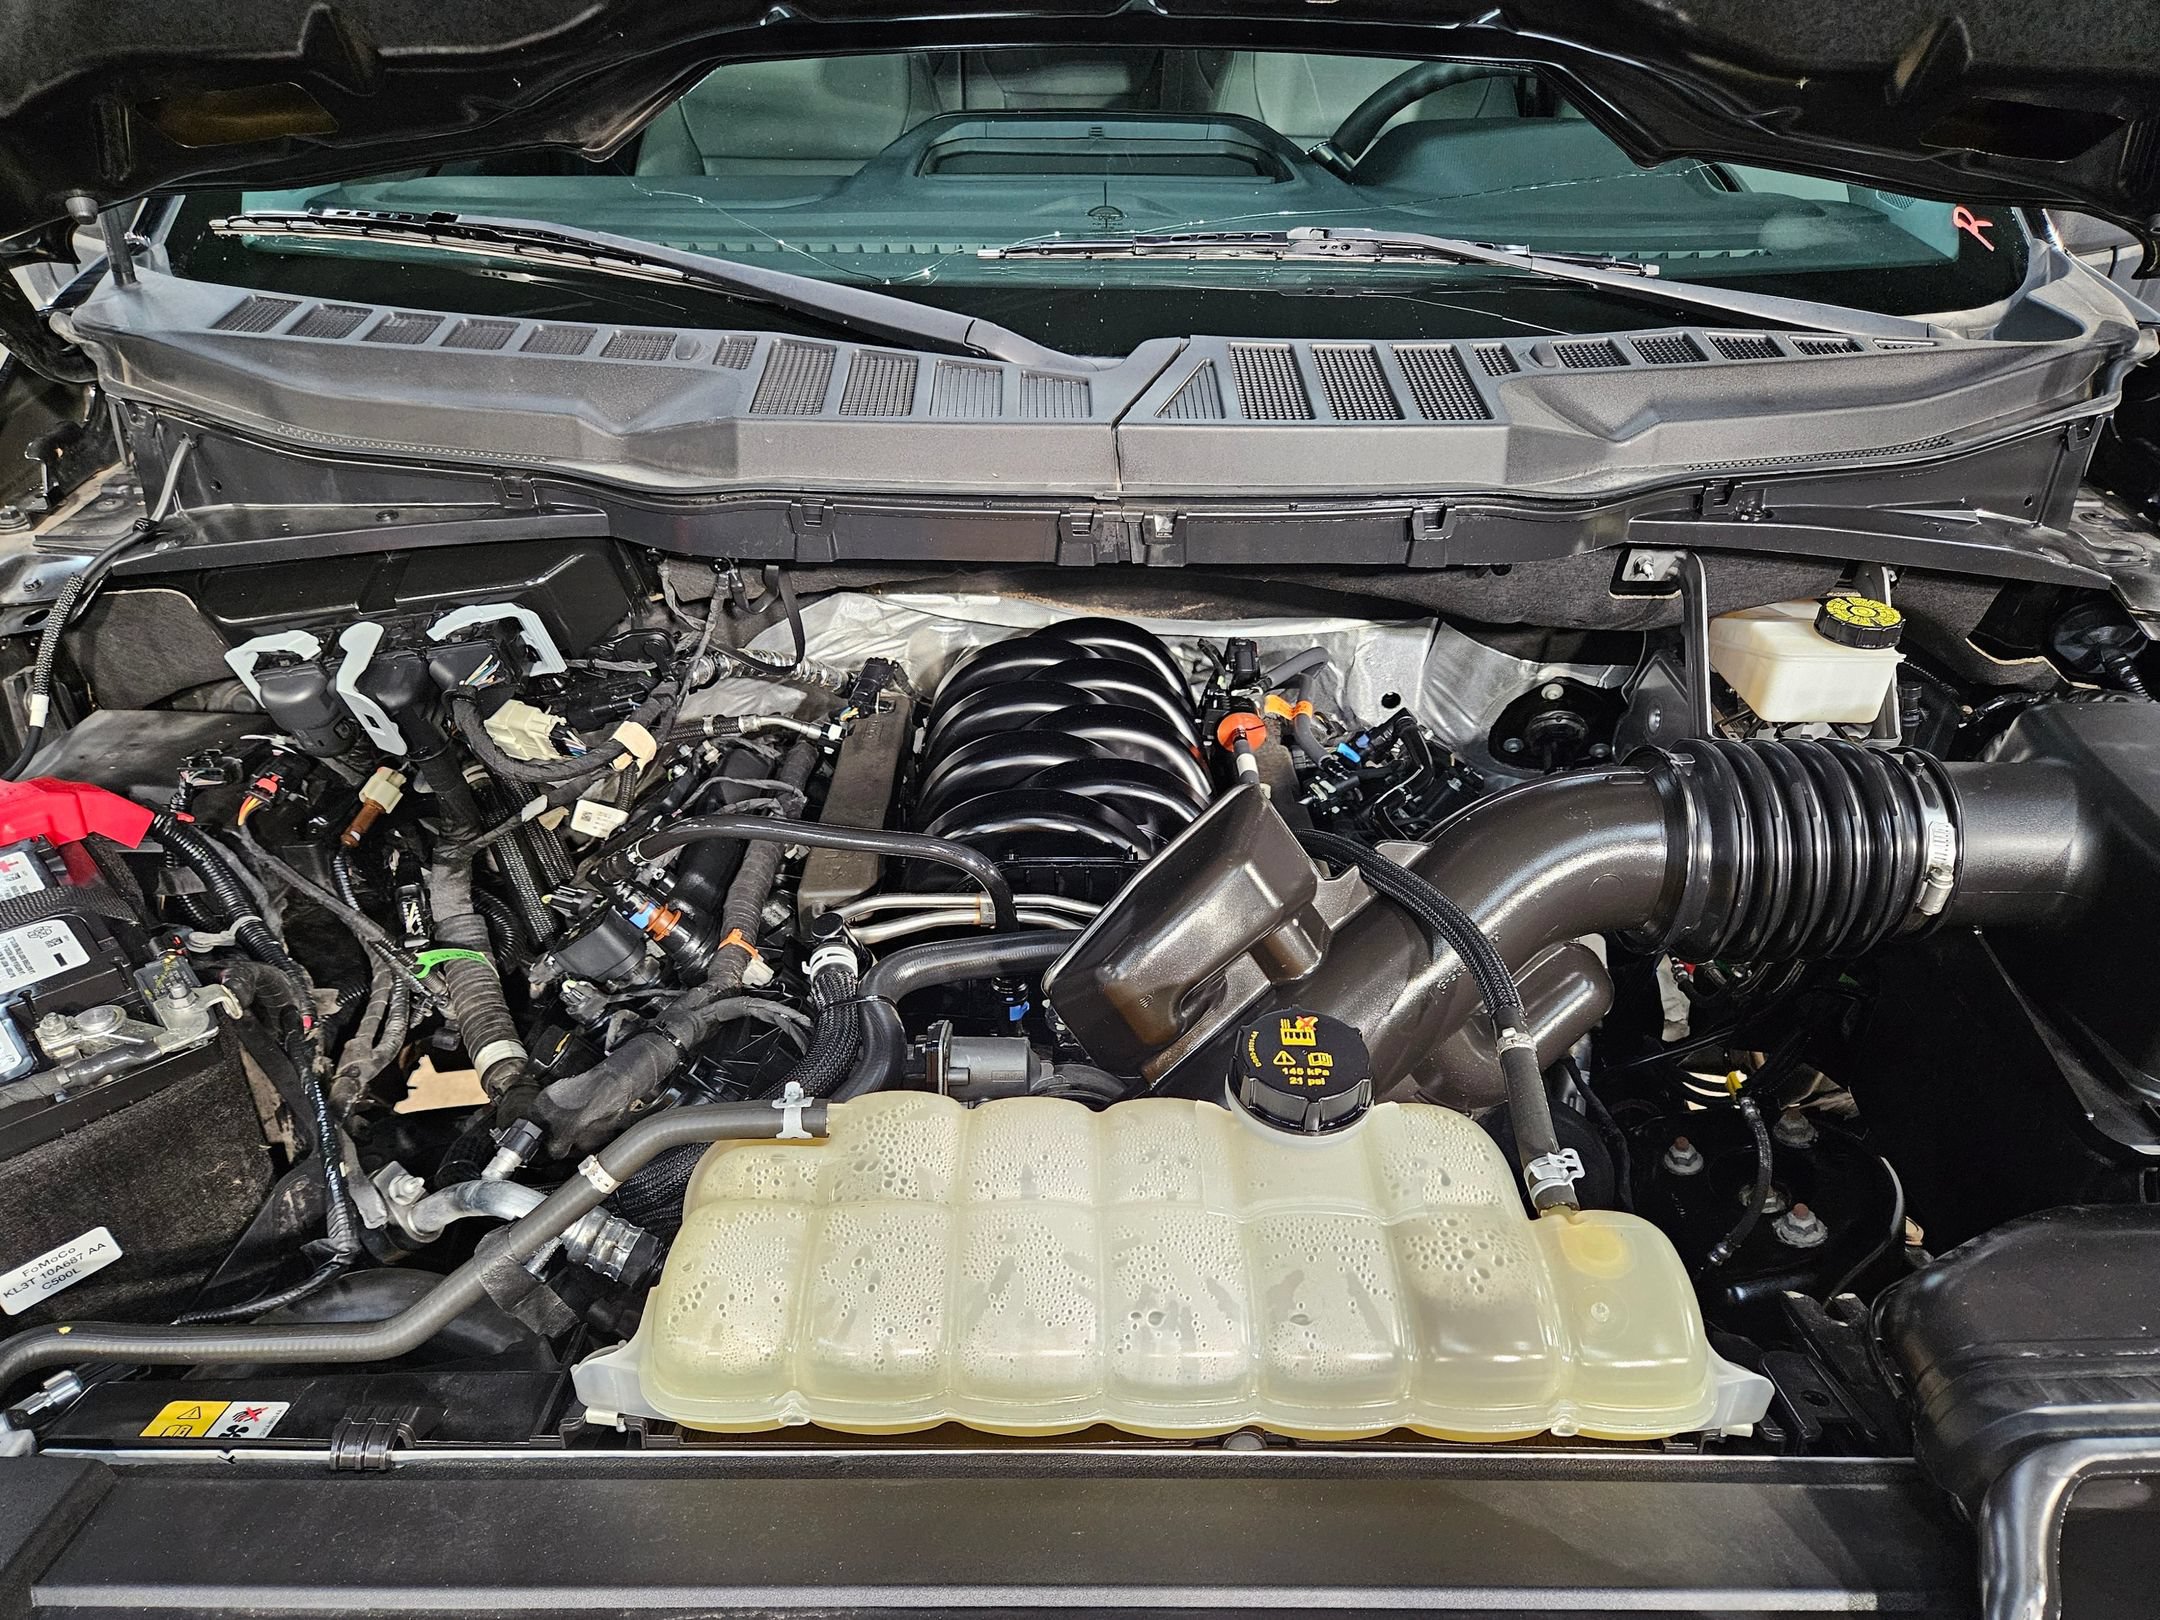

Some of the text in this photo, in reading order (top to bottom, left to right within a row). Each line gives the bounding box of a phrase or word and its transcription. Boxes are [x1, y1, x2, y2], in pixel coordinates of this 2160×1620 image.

[1953, 206, 1995, 252] R
[1289, 1076, 1326, 1086] 21 psi
[1307, 1067, 1330, 1076] kPa
[3, 1243, 107, 1298] KL3T 10A687 AA
[22, 1247, 76, 1277] FoMoCo
[42, 1268, 82, 1290] C500L
